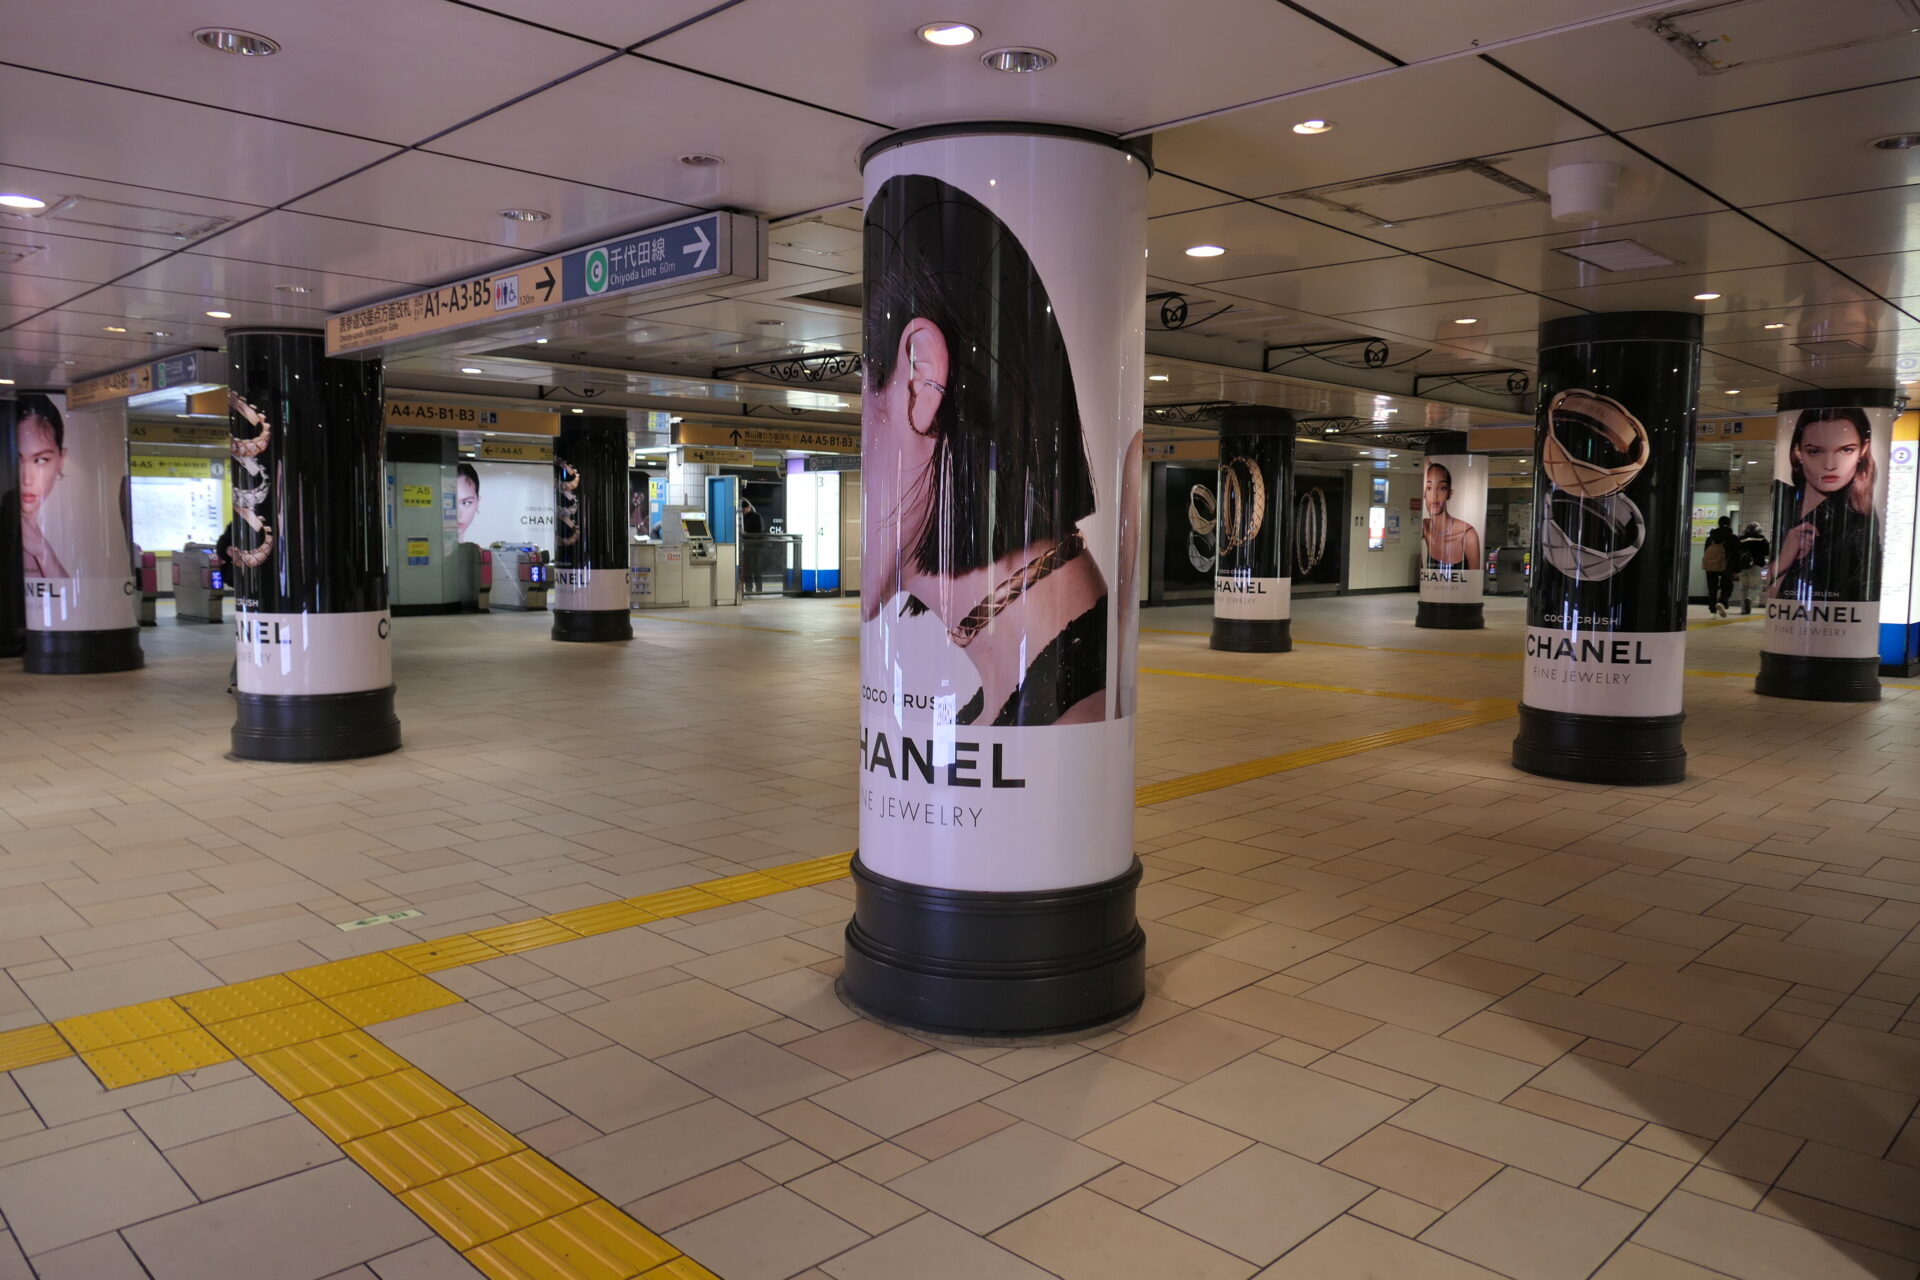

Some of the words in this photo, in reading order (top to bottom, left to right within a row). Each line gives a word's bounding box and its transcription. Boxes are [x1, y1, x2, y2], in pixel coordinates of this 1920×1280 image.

[610, 238, 666, 272] 千代田線
[610, 270, 640, 286] Chiyoda
[641, 266, 657, 279] Line
[659, 261, 676, 274] 60m
[520, 516, 553, 525] CHAN
[1216, 580, 1267, 594] HANEL
[1543, 613, 1572, 624] COCO
[1577, 615, 1619, 626] CRUSH
[1768, 603, 1862, 623] CHANEL
[1526, 633, 1652, 665] CHANEL
[1533, 665, 1558, 681] FINE
[1562, 670, 1631, 685] JEWELRY
[859, 726, 1026, 788] HANEL
[880, 794, 983, 828] JEWELRY
